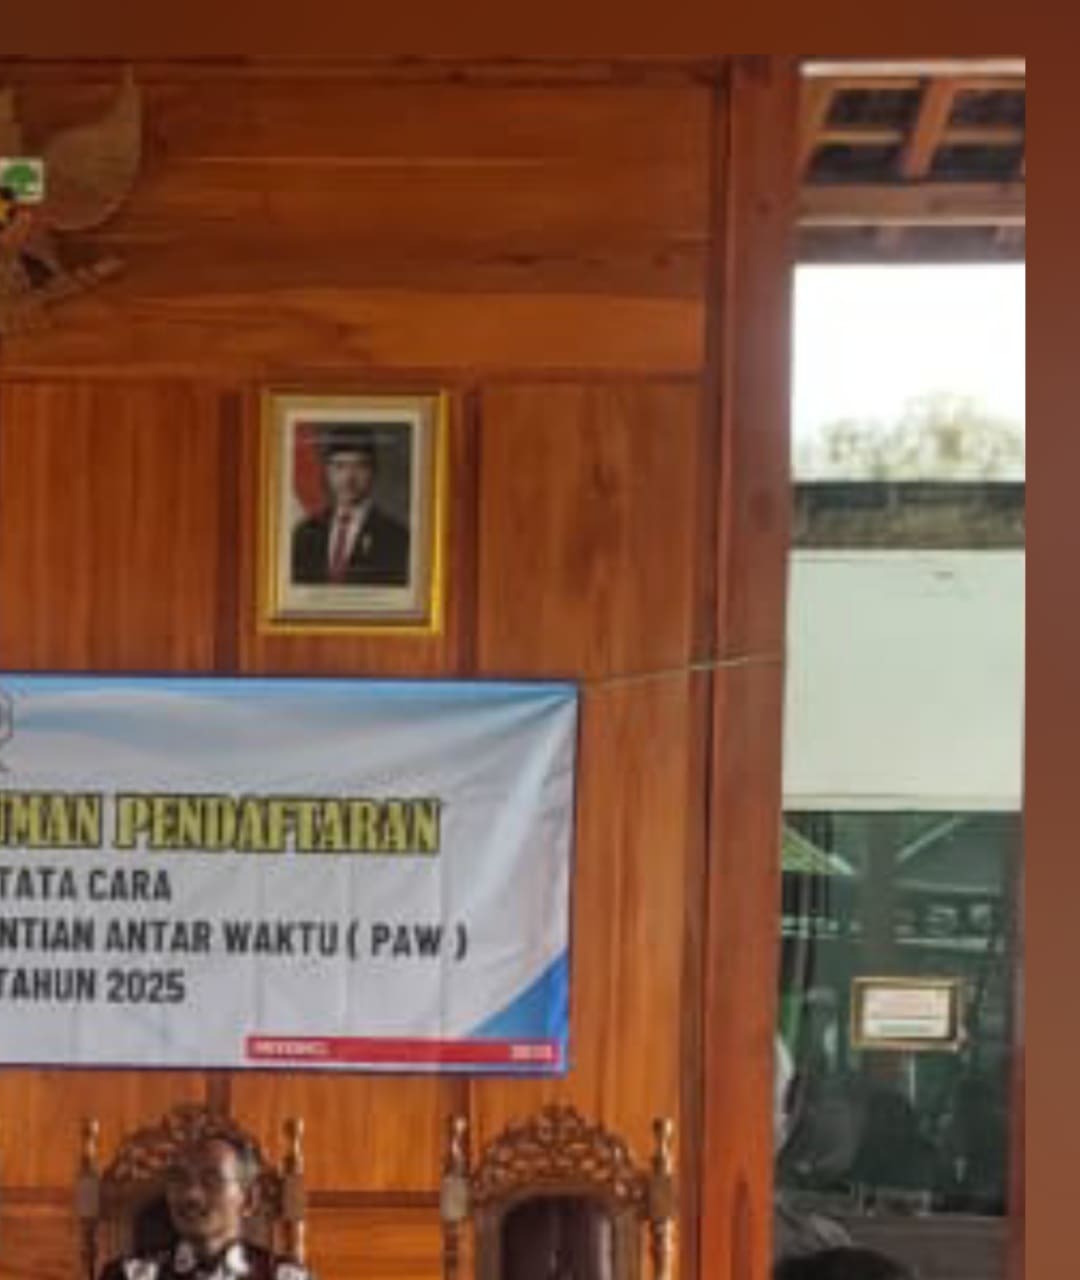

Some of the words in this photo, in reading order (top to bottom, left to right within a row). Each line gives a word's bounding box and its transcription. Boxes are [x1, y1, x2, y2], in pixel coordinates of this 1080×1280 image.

[112, 792, 441, 855] PENDAFTARAN
[89, 869, 172, 901] CARA
[106, 918, 212, 954] ANTAR
[220, 921, 338, 956] WAKTU
[370, 924, 442, 957] PAW
[107, 970, 186, 1003] 2025
